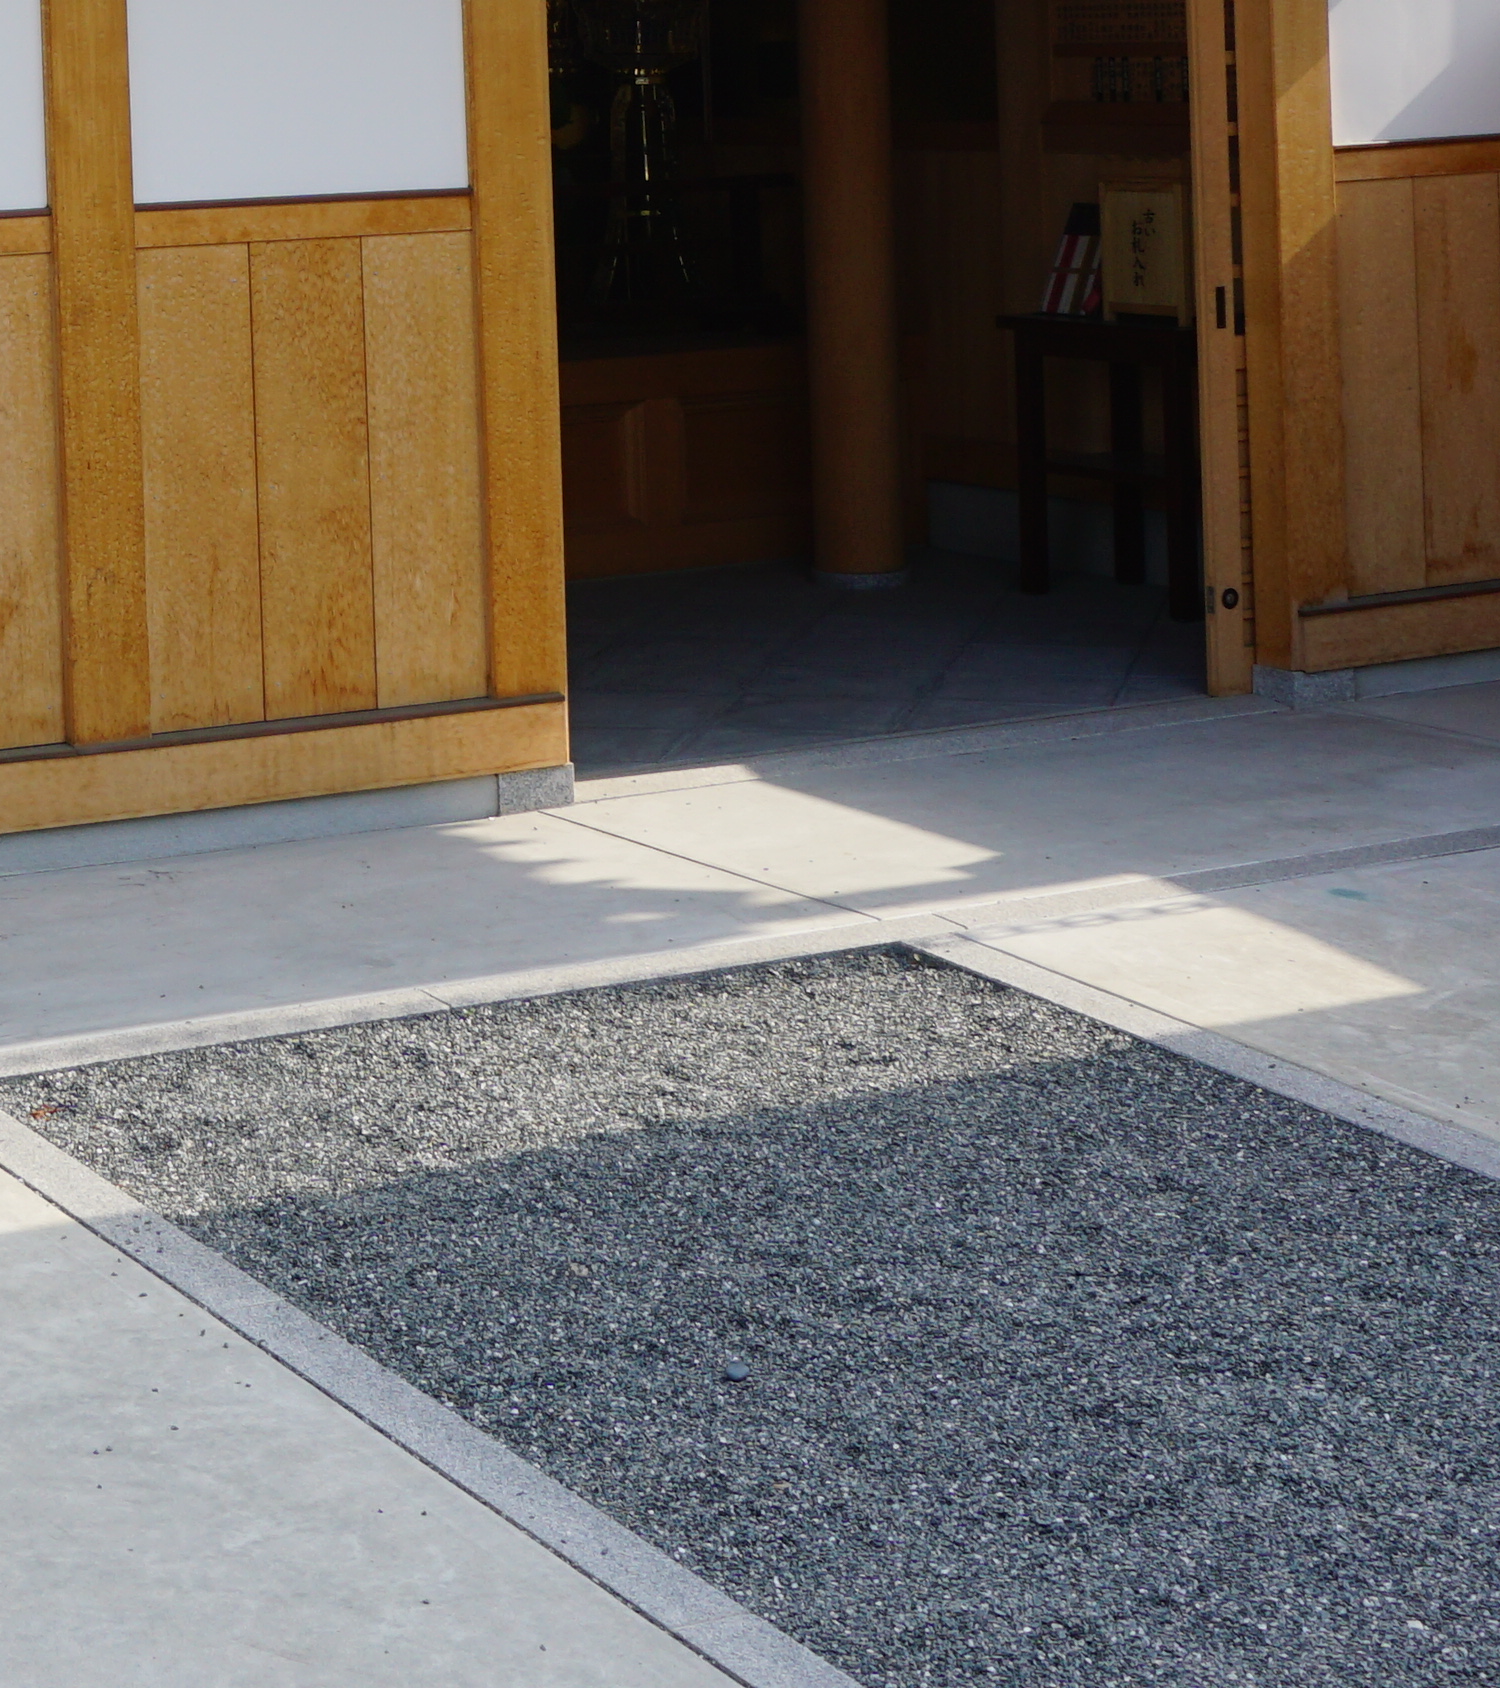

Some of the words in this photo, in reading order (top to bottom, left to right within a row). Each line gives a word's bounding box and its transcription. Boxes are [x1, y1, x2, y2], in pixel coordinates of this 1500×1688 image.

[1142, 208, 1157, 237] 古い
[1131, 220, 1147, 288] お札入れ
